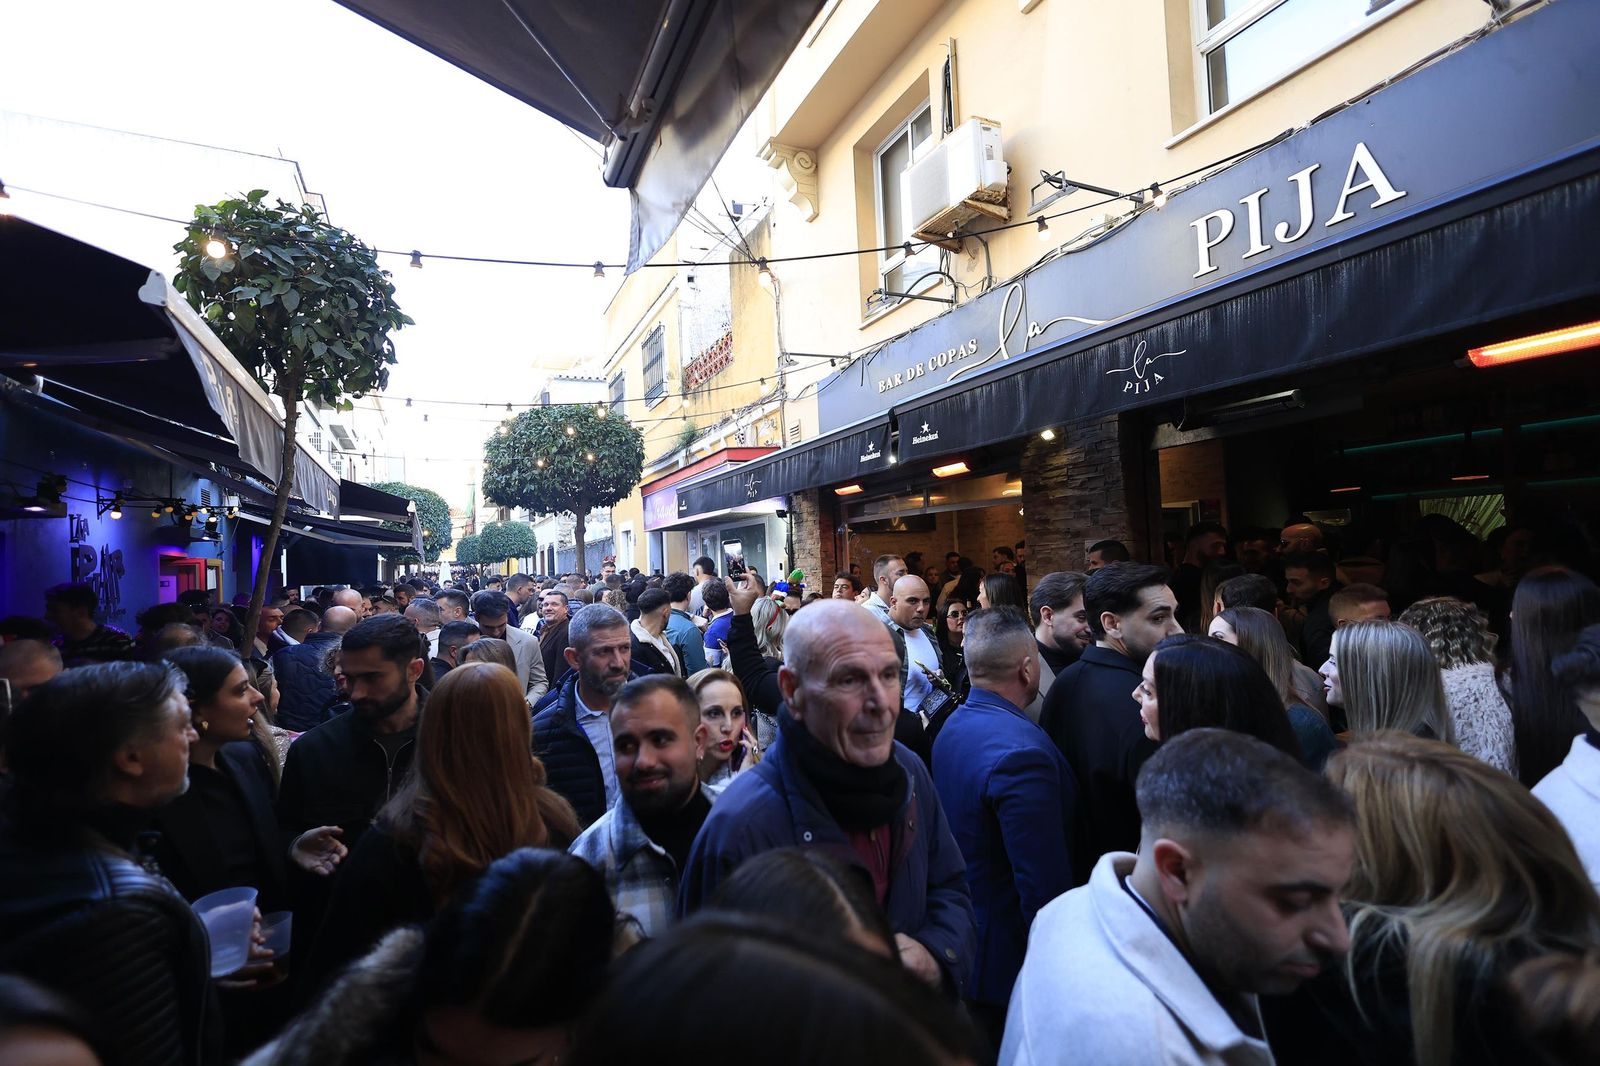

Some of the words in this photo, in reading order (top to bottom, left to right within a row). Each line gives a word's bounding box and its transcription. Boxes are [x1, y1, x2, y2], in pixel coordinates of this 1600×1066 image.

[1190, 142, 1408, 279] PIJA
[878, 373, 903, 393] BAR
[906, 362, 925, 382] DE
[928, 338, 978, 372] COPAS
[1106, 340, 1187, 379] la
[1122, 372, 1165, 394] PIJA
[912, 430, 939, 444] Heineken
